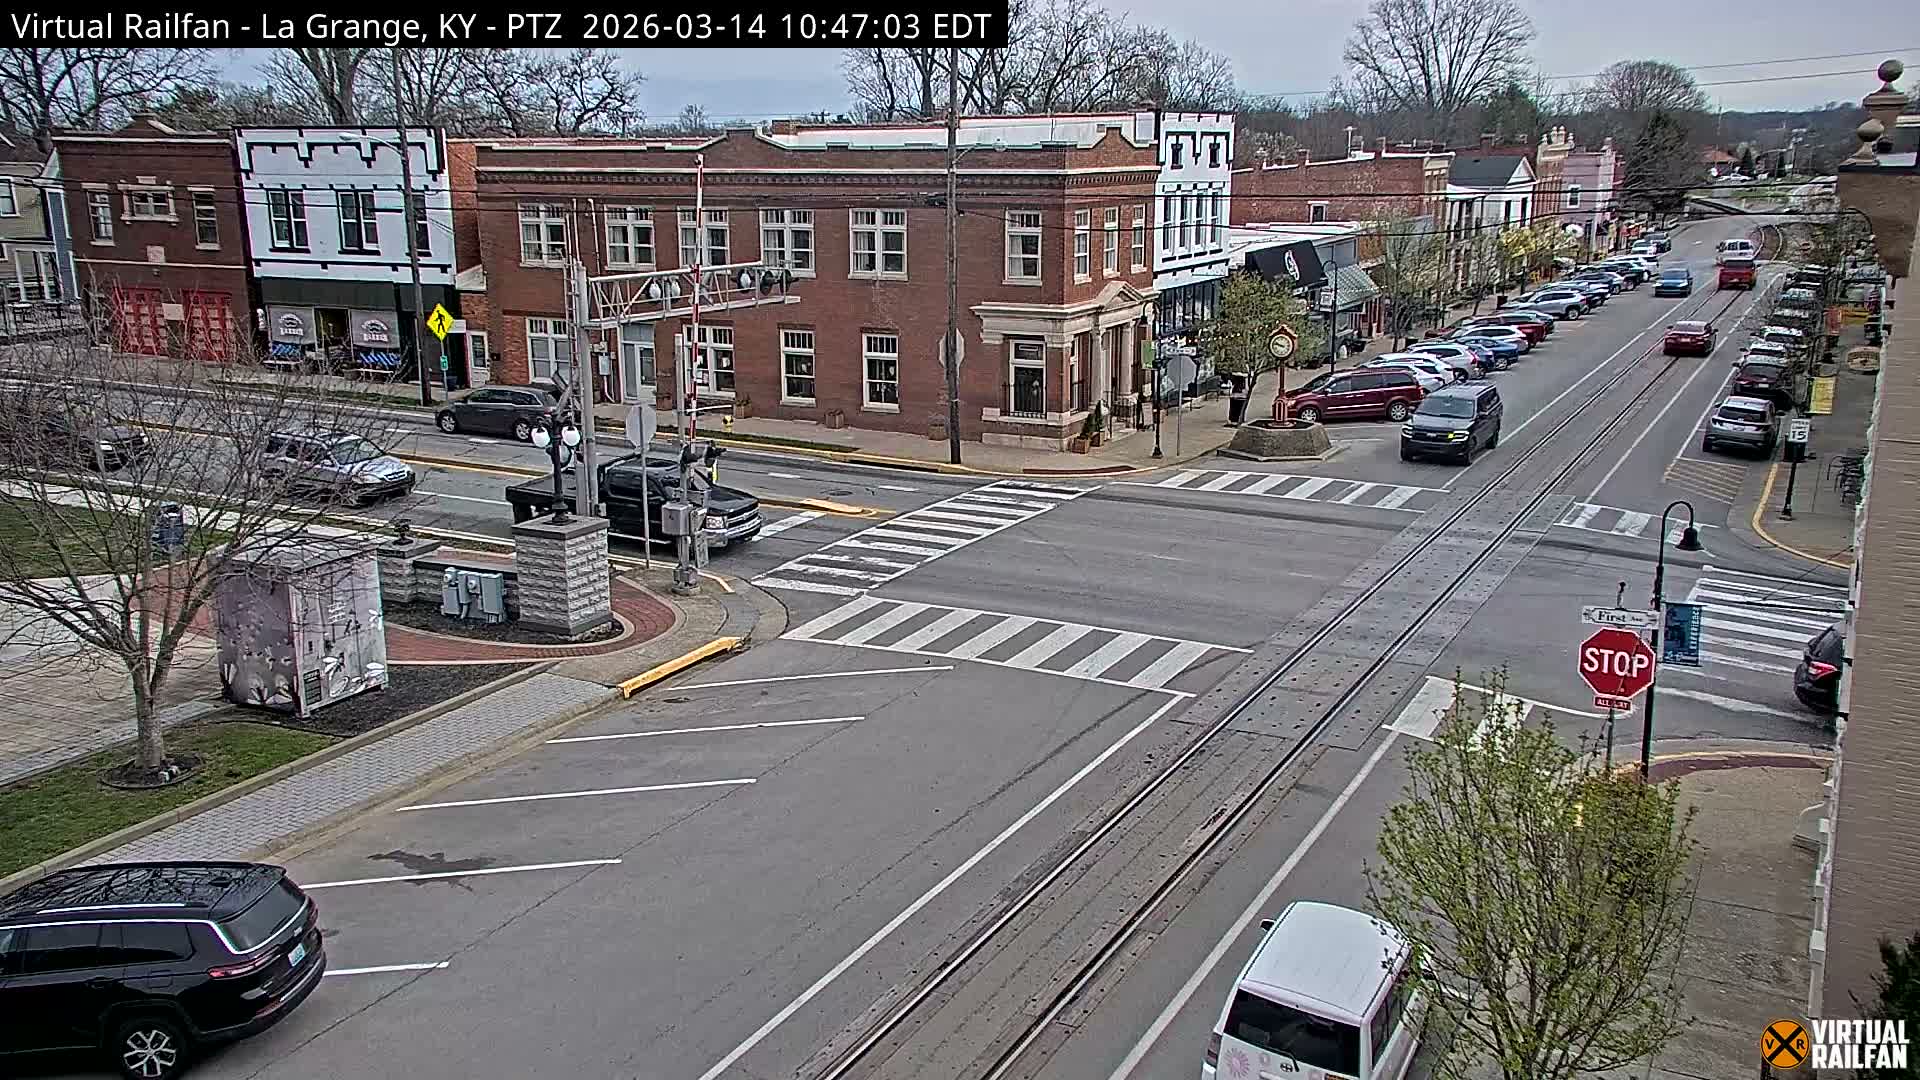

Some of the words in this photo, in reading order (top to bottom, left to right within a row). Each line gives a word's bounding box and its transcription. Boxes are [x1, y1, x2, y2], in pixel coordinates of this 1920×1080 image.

[1792, 430, 1807, 441] 15
[1598, 611, 1626, 622] First
[1583, 647, 1649, 678] STOP
